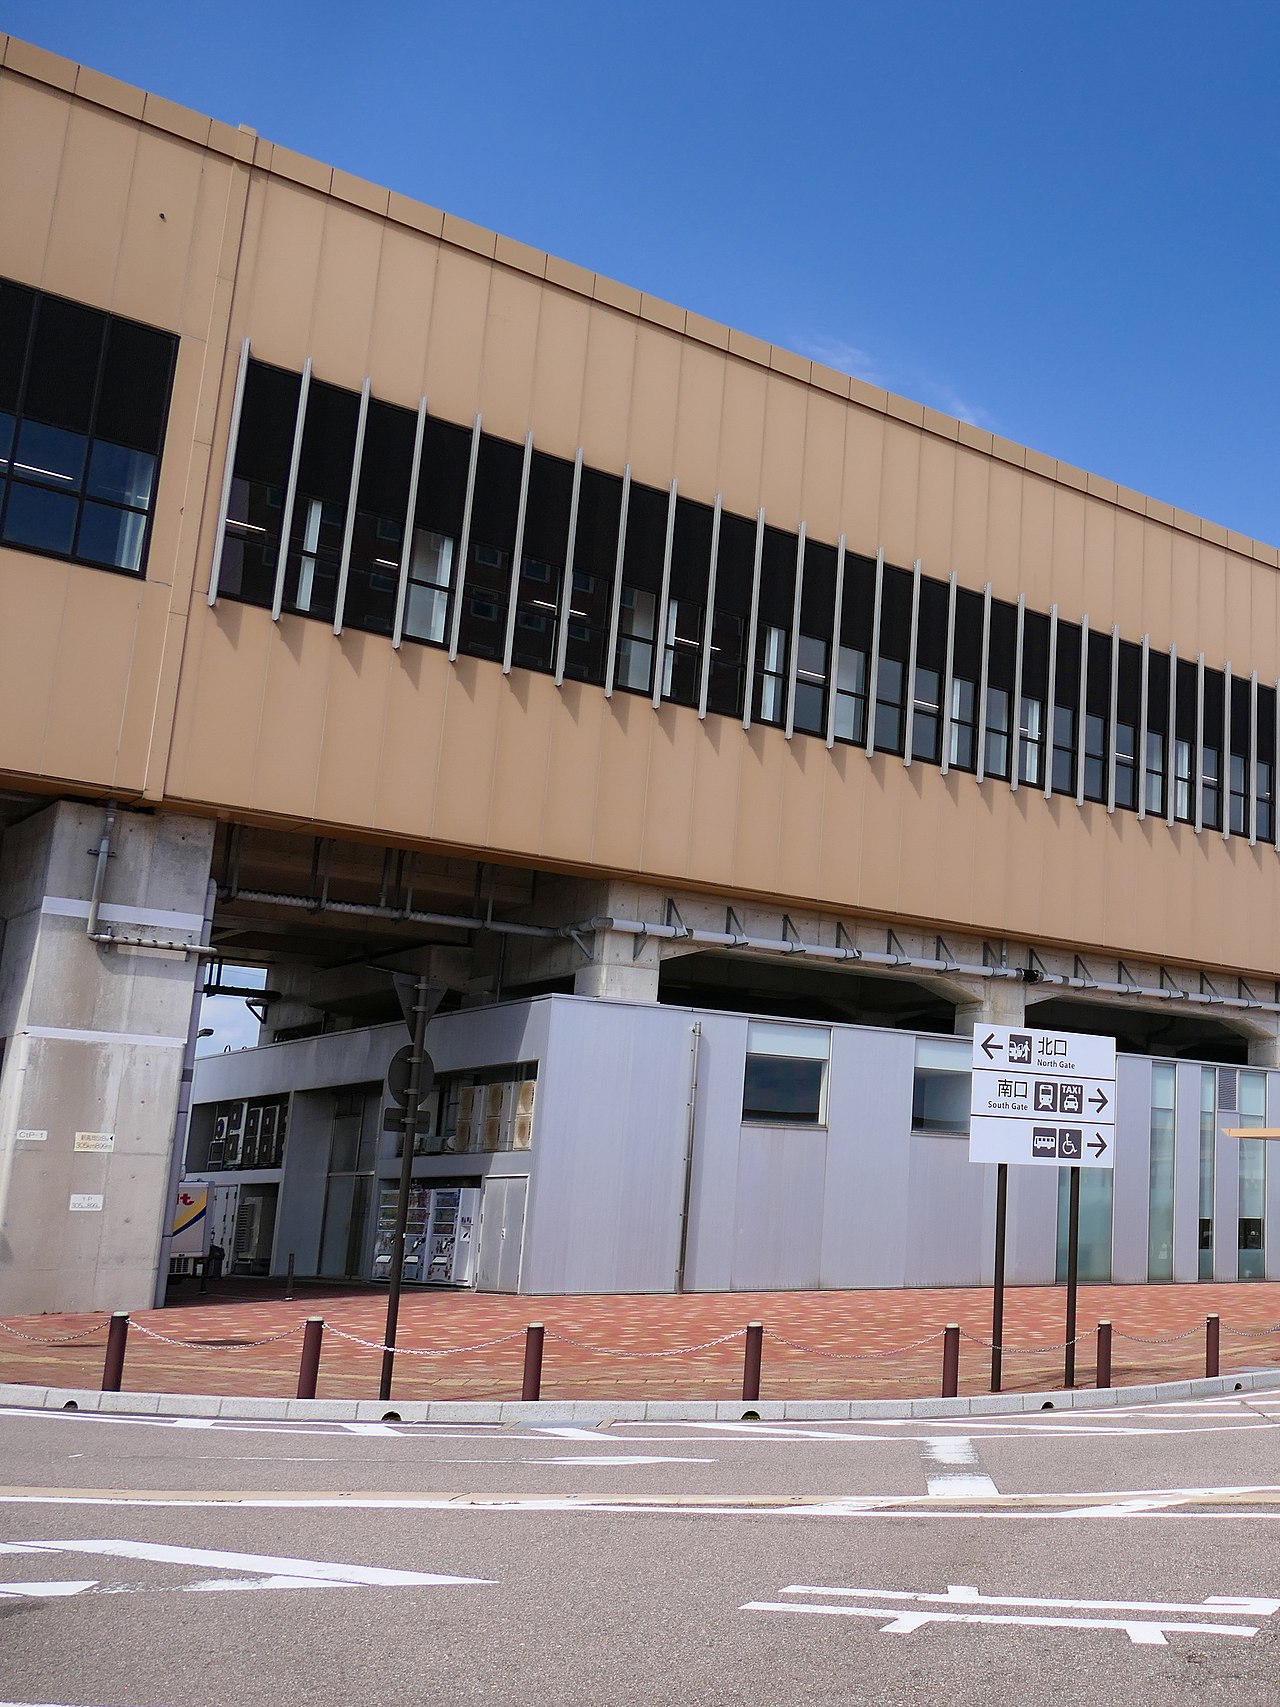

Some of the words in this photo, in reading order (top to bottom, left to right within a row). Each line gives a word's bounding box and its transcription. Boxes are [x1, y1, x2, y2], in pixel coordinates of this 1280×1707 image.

[1038, 1036, 1068, 1057] 北口
[1037, 1059, 1058, 1068] North
[1059, 1061, 1076, 1070] Gate
[997, 1079, 1028, 1099] 南口
[1061, 1085, 1082, 1095] TAXI
[988, 1101, 1010, 1110] South
[1011, 1102, 1029, 1111] Gate
